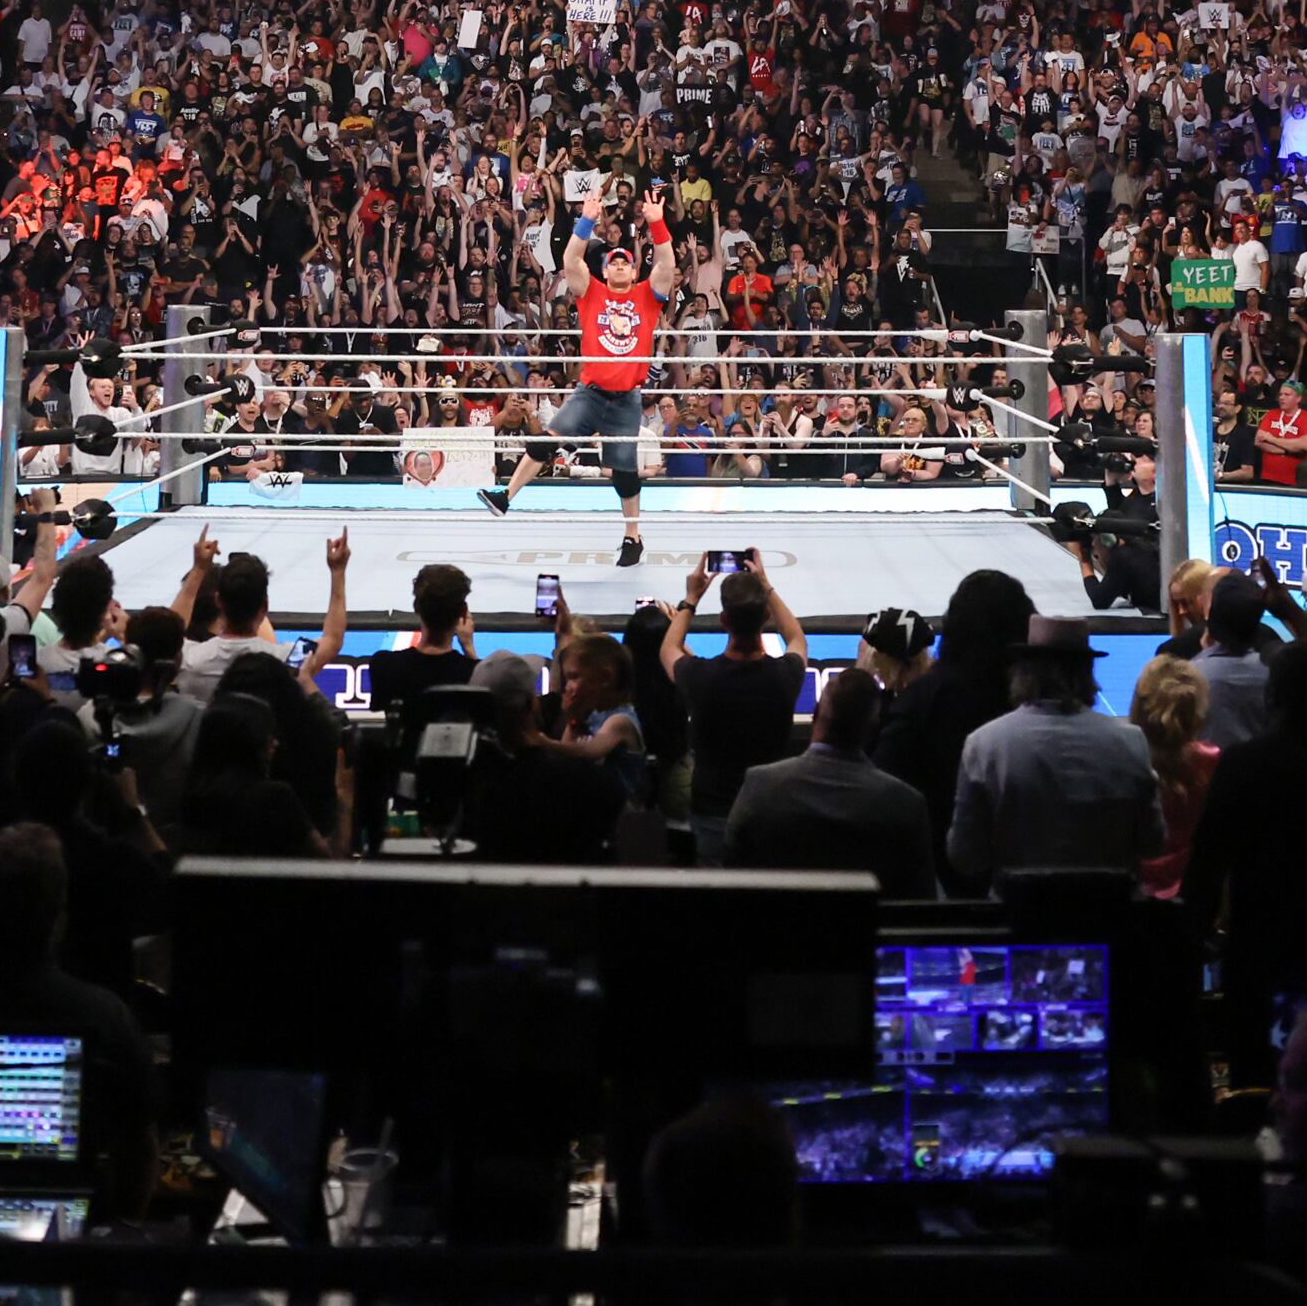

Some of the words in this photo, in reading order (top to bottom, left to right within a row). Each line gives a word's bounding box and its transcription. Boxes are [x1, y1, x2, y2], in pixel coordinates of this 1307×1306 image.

[569, 10, 597, 21] HERE
[585, 5, 594, 13] IS
[676, 88, 713, 105] PRIME
[1183, 265, 1233, 284] YEET
[1184, 287, 1234, 303] BANK
[518, 550, 706, 568] PRM
